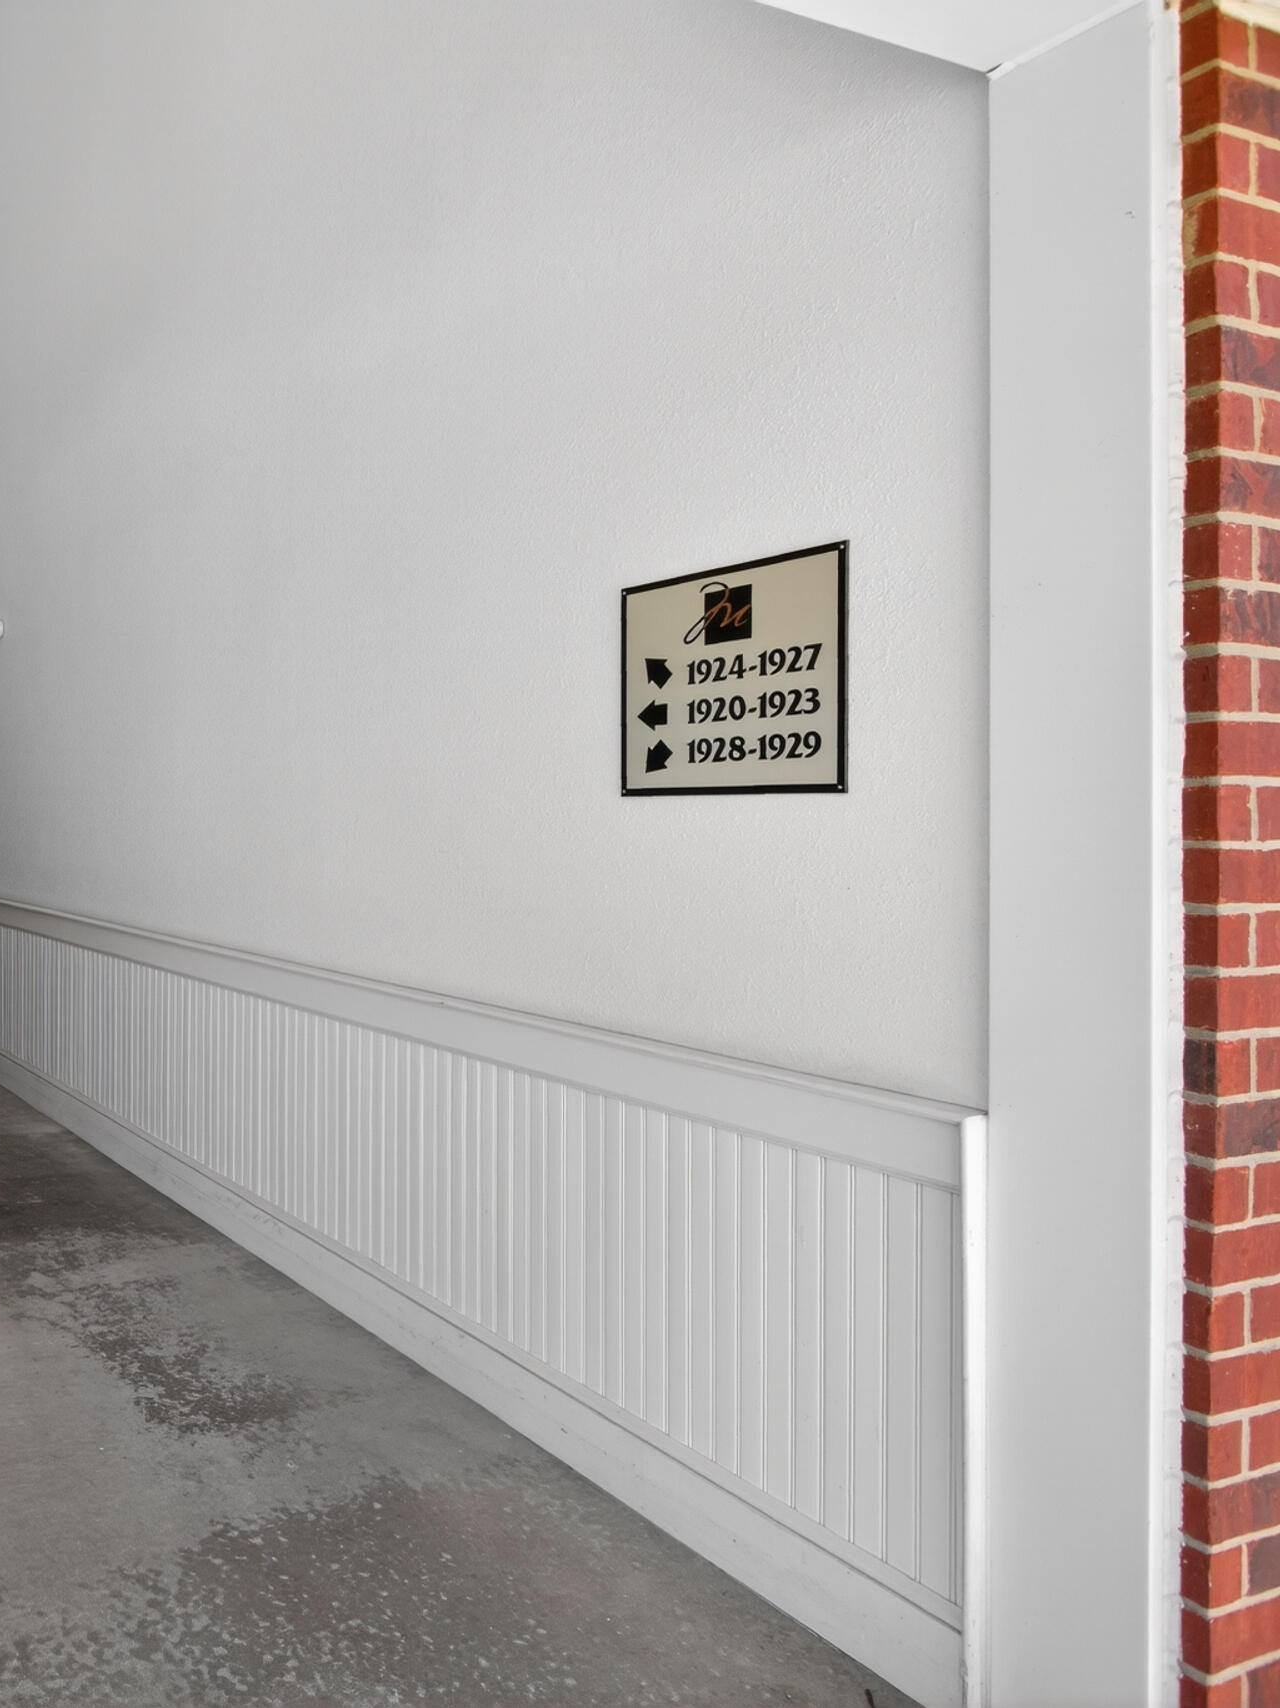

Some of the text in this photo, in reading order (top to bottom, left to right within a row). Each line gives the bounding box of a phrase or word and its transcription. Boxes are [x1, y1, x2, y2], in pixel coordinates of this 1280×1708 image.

[686, 642, 823, 686] 1924-1927
[686, 687, 821, 725] 1920-1923
[686, 730, 822, 764] 1928-1929
